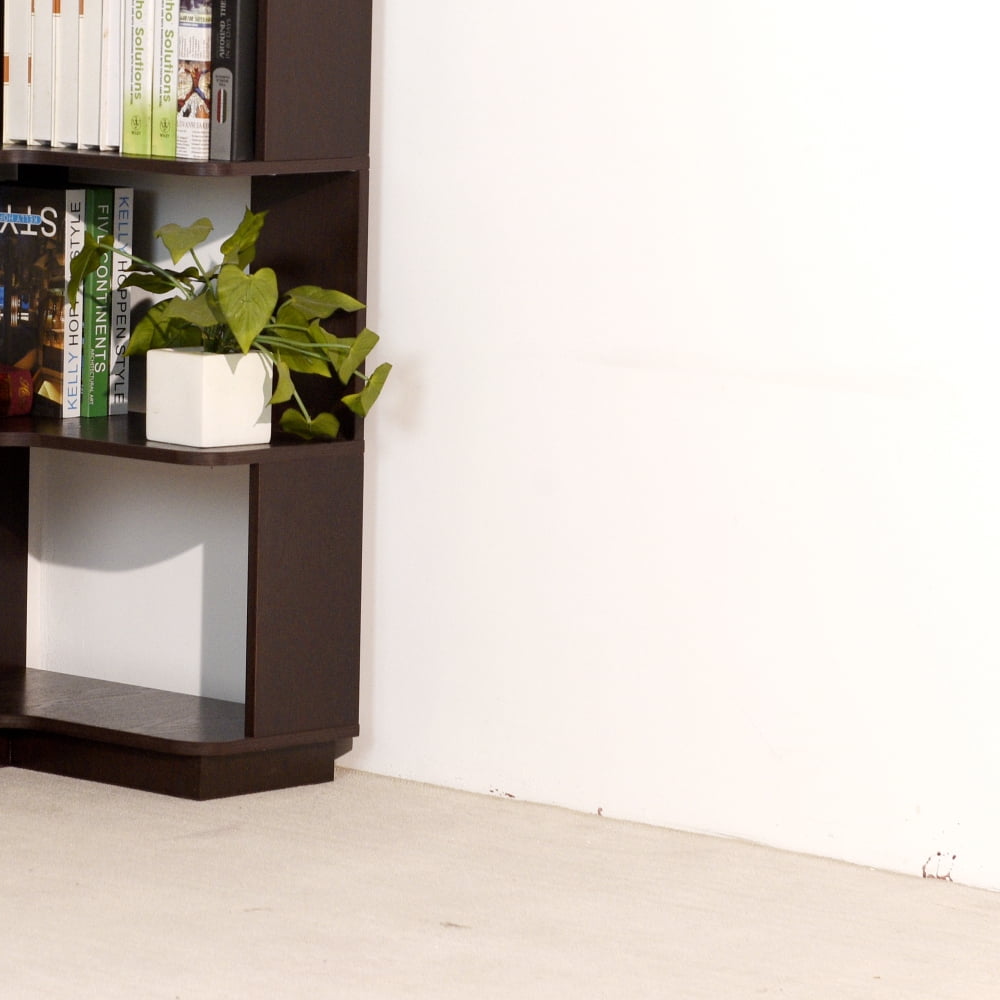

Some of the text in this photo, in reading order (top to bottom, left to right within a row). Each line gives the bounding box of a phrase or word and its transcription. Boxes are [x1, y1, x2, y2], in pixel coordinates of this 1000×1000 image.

[134, 27, 145, 100] Solutions
[163, 29, 174, 102] Solutions
[218, 20, 226, 59] AROUND
[70, 201, 81, 259] STYLE
[67, 352, 79, 410] KELLY
[114, 345, 127, 404] STYLE
